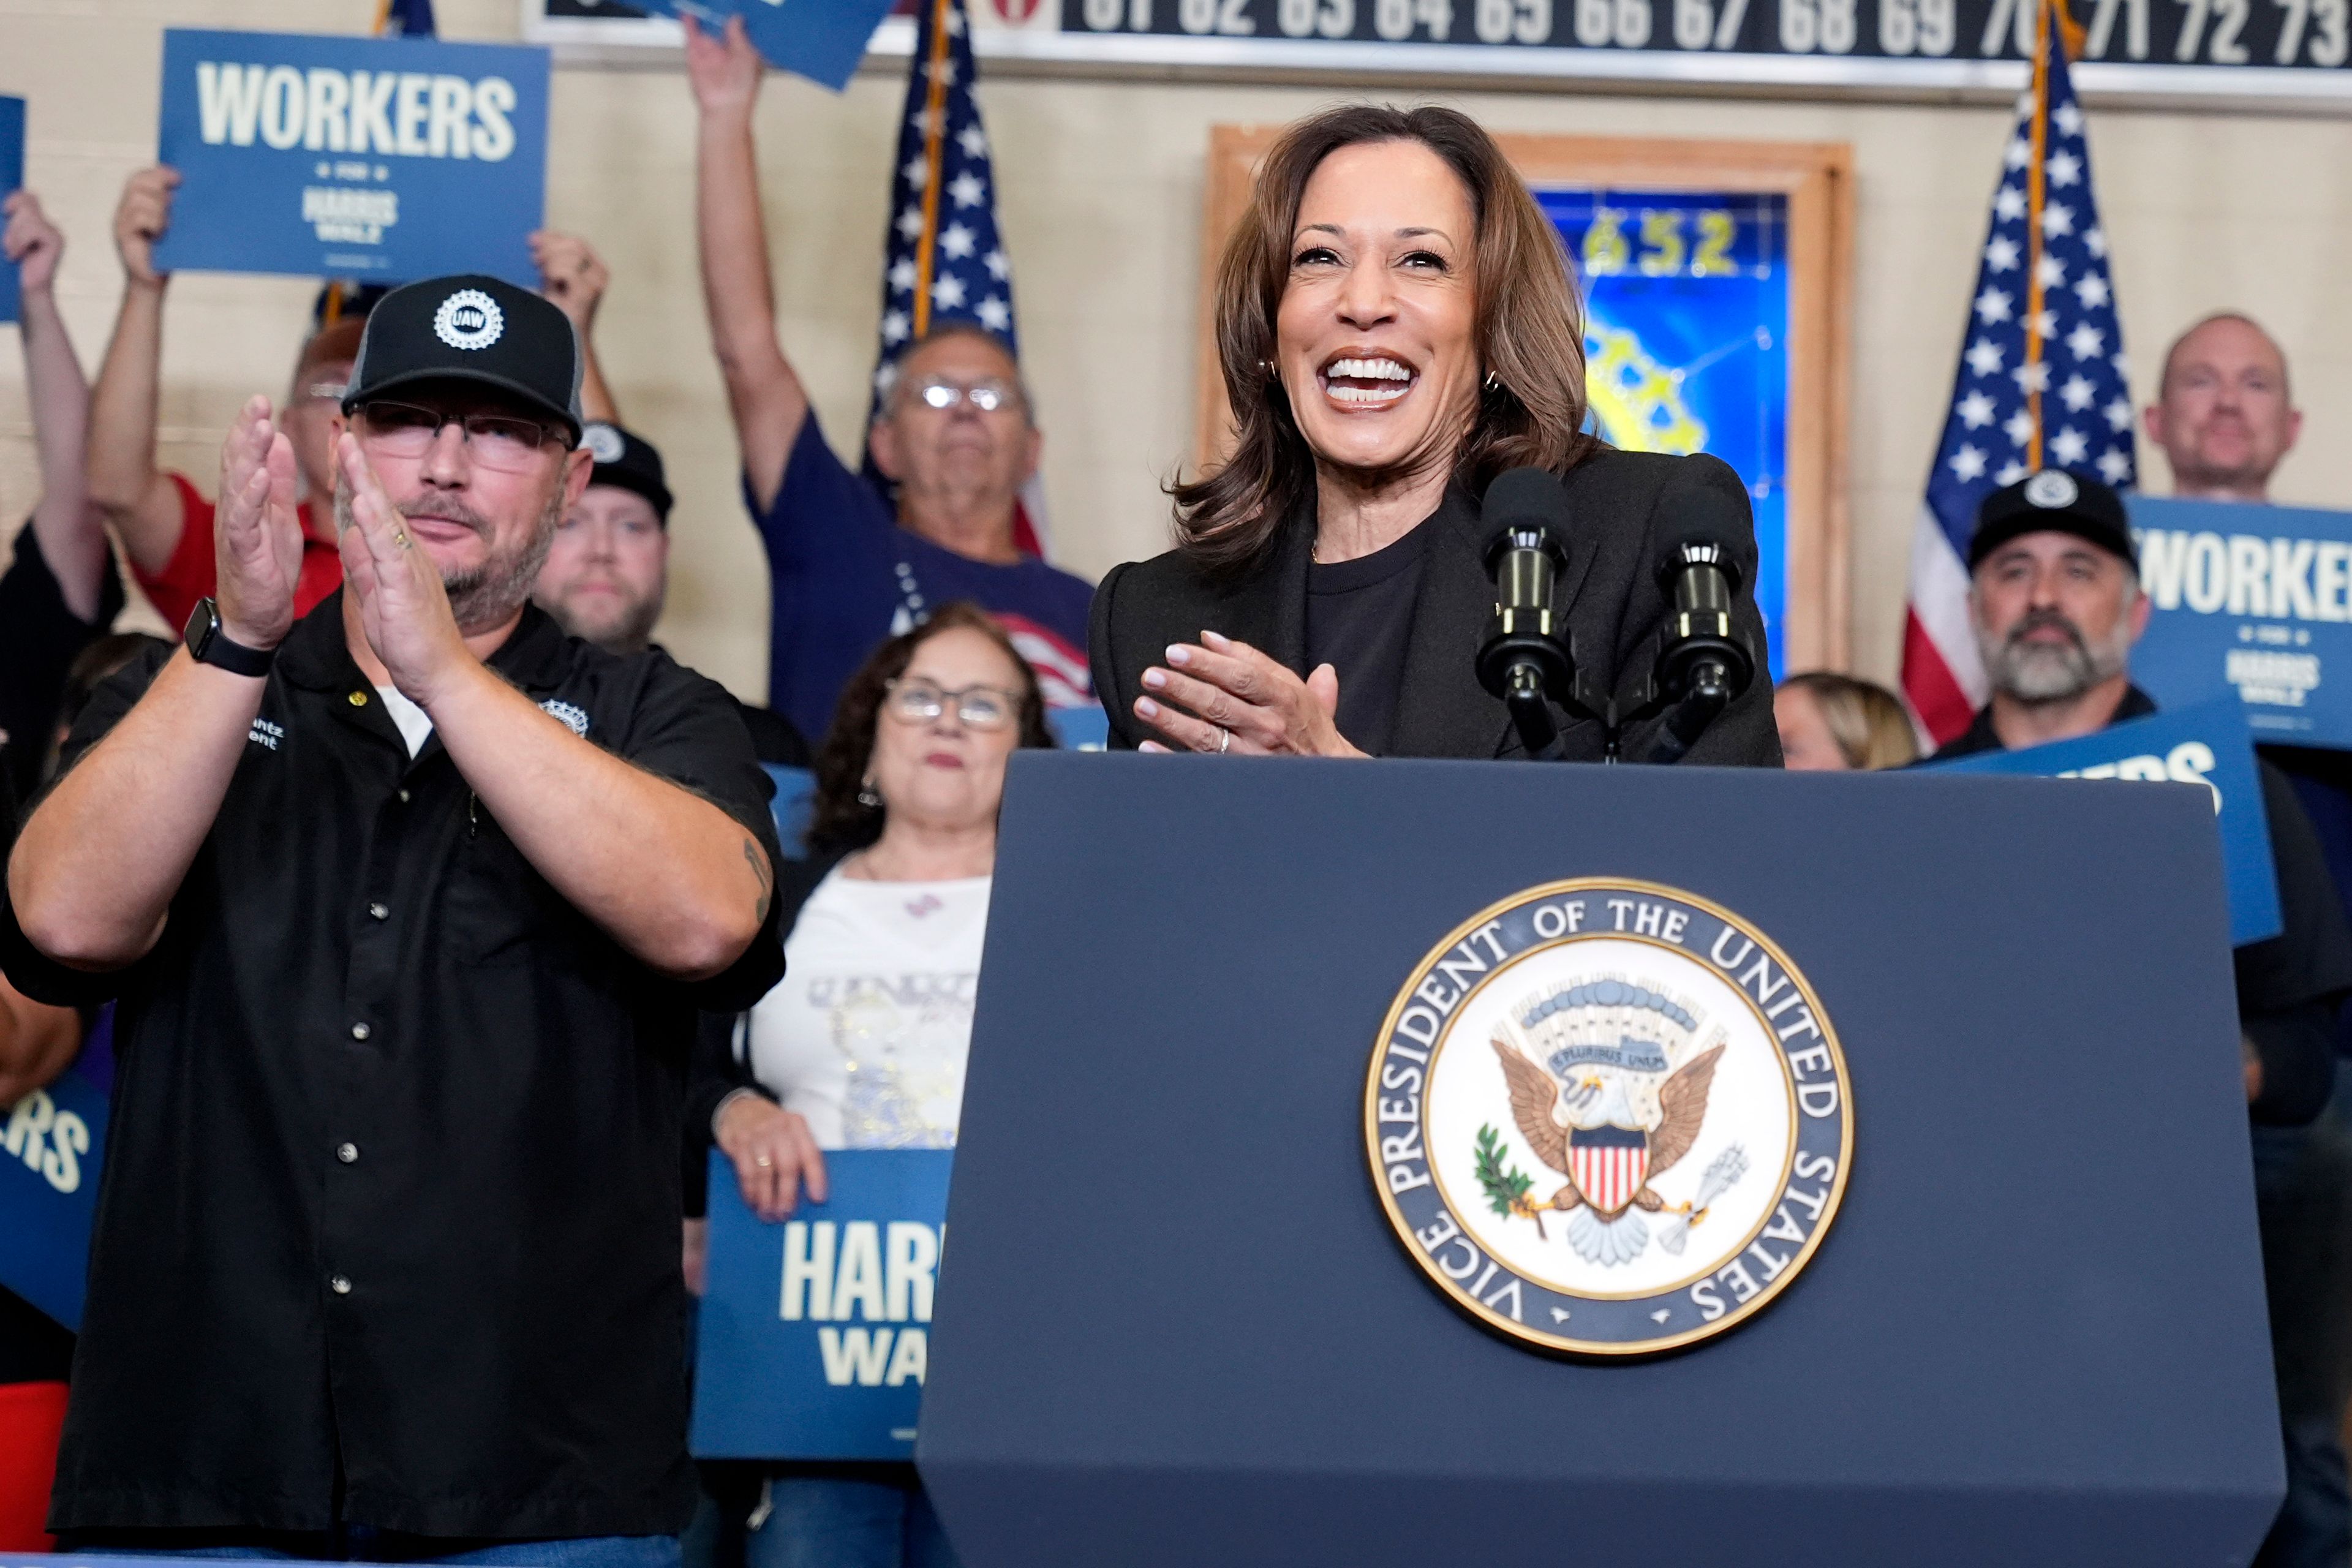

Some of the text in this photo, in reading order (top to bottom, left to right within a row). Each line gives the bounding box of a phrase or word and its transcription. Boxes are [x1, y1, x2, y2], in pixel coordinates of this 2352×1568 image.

[1879, 0, 1956, 56] 69
[2175, 0, 2250, 62] 72
[2274, 0, 2347, 66] 73
[196, 60, 517, 163] WORKERS
[1582, 210, 1738, 277] 652
[452, 310, 486, 329] UAW
[2130, 527, 2352, 623] WORKE
[0, 1089, 90, 1193] RS
[1378, 899, 1838, 1323] VICE PRESIDENT OF THE UNITED STATES
[778, 1222, 946, 1321] HAR
